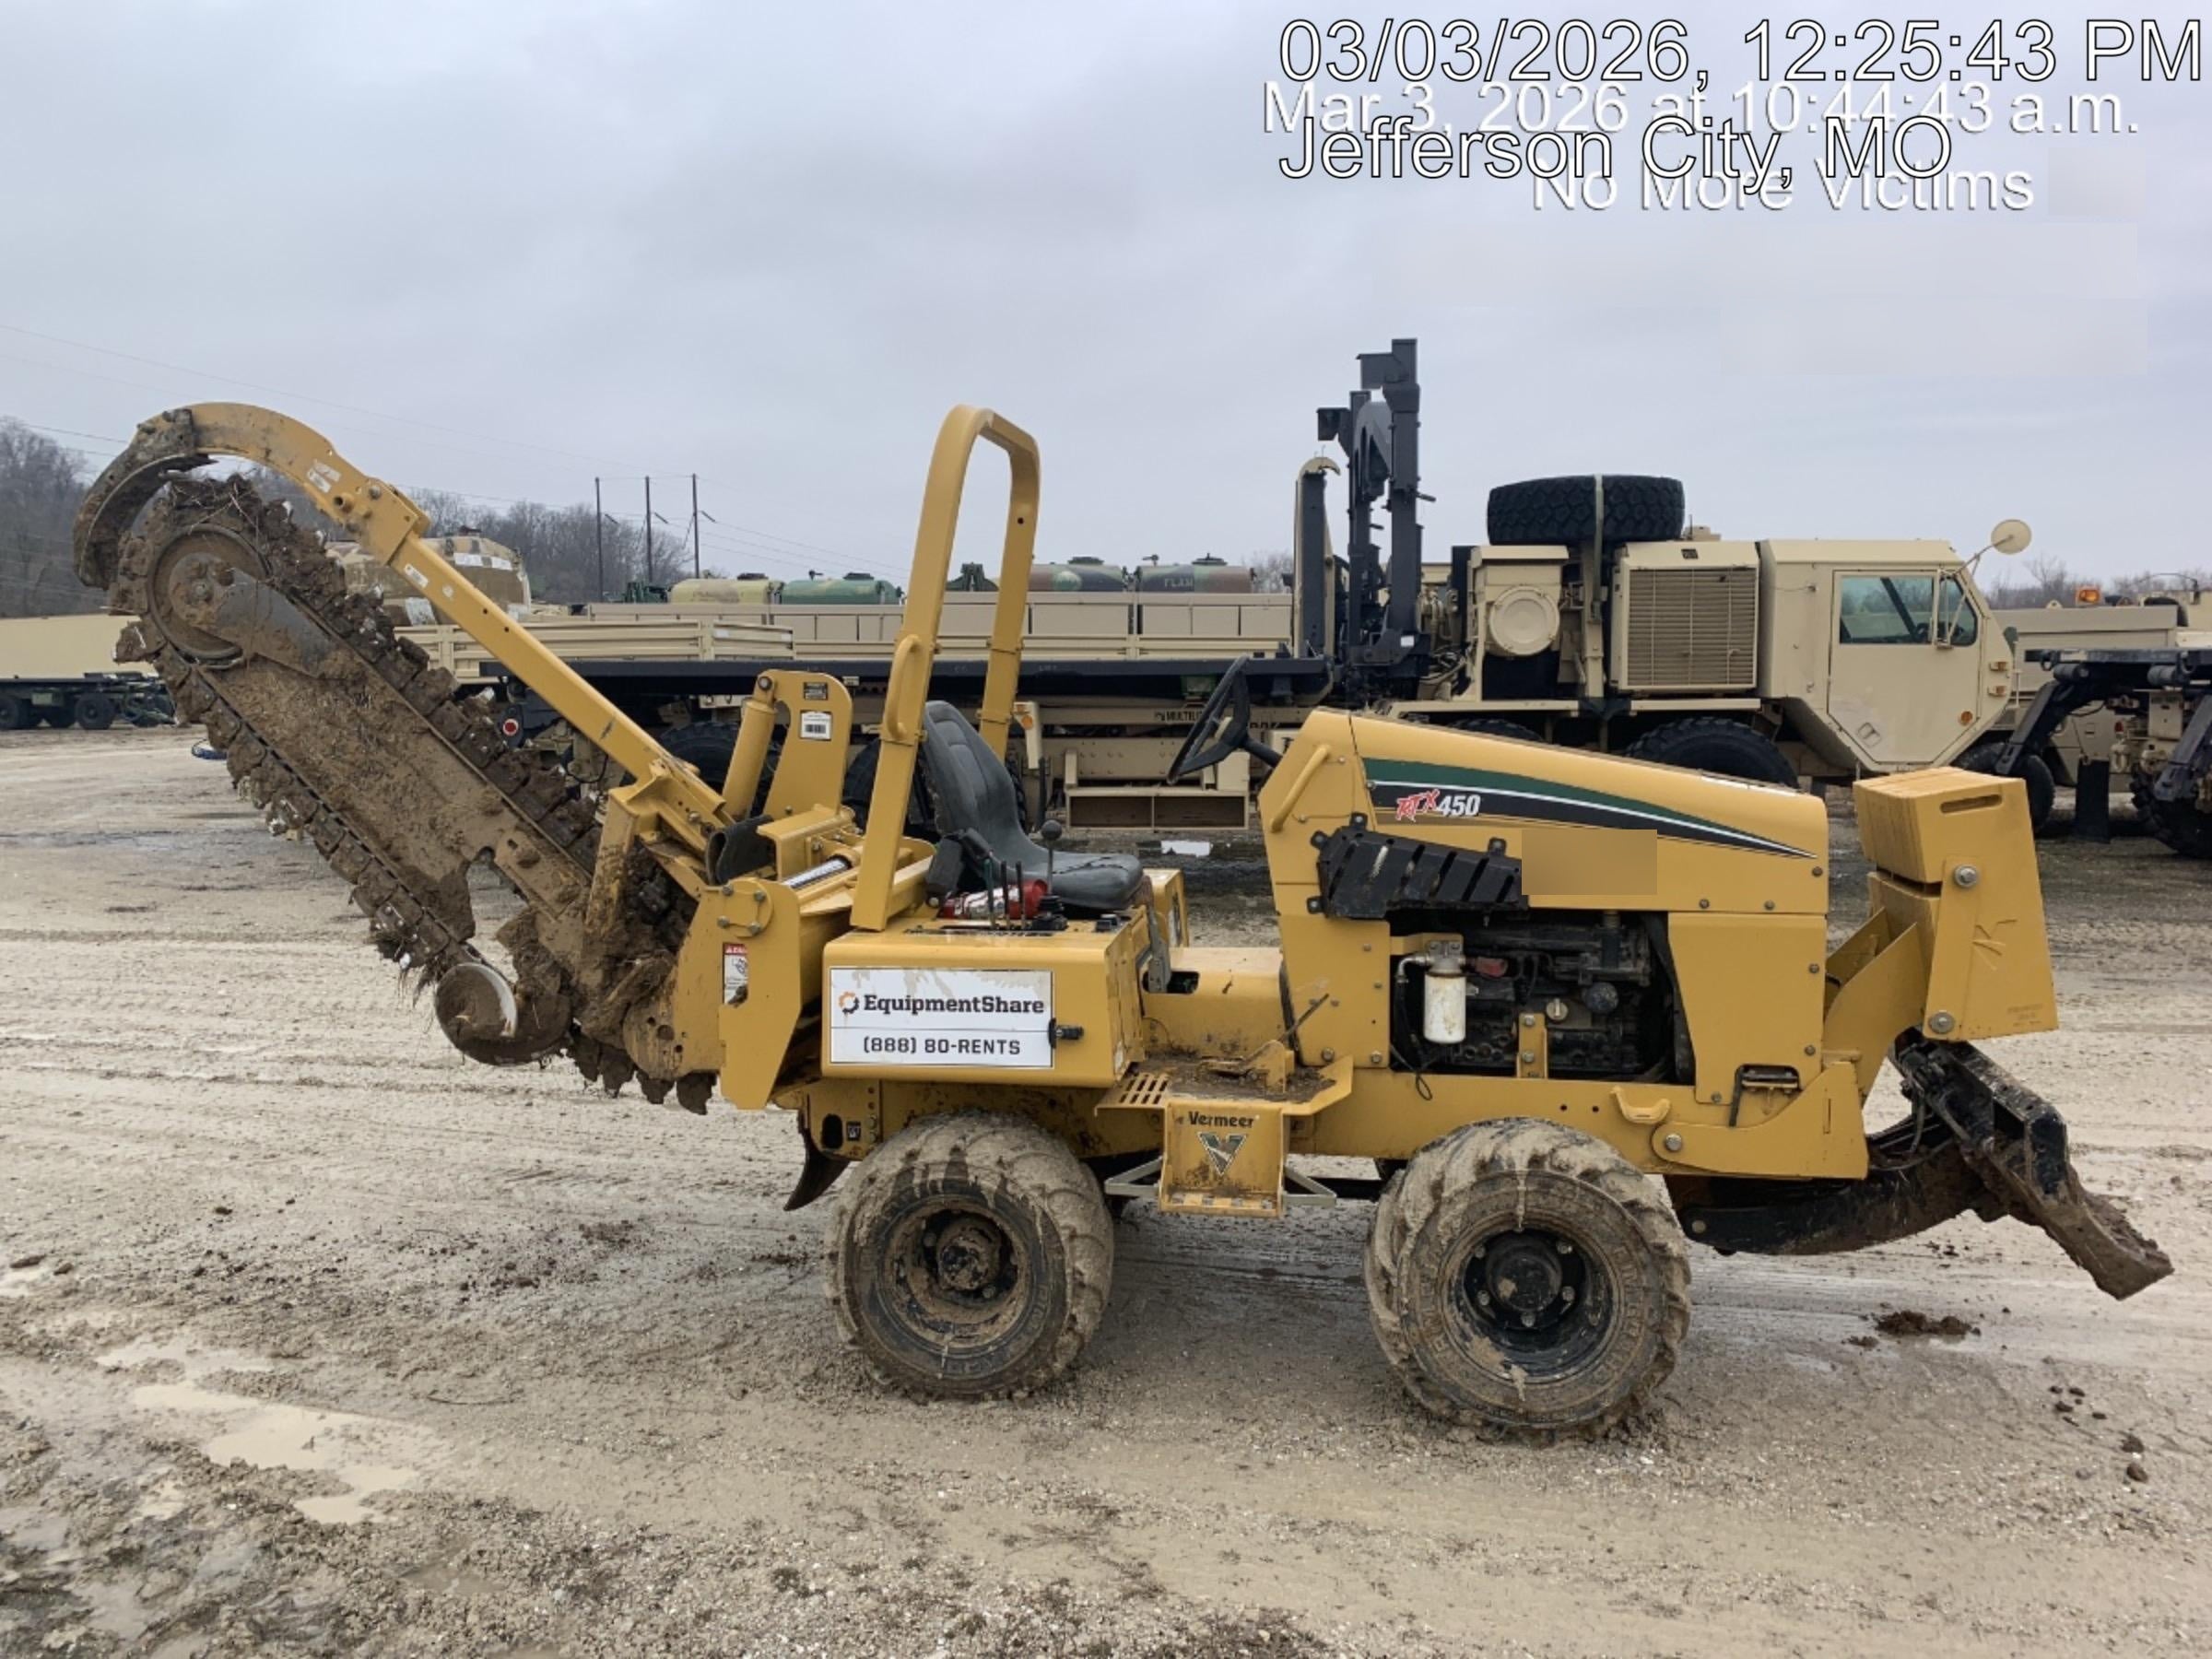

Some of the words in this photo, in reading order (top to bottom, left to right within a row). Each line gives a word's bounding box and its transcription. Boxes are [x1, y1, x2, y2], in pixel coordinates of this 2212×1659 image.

[1438, 794, 1481, 818] 450
[864, 994, 1044, 1015] EquipmentShare
[863, 1037, 917, 1053] (888)
[924, 1039, 1021, 1055] 80-RENTS
[1189, 1112, 1254, 1128] Vermeer
